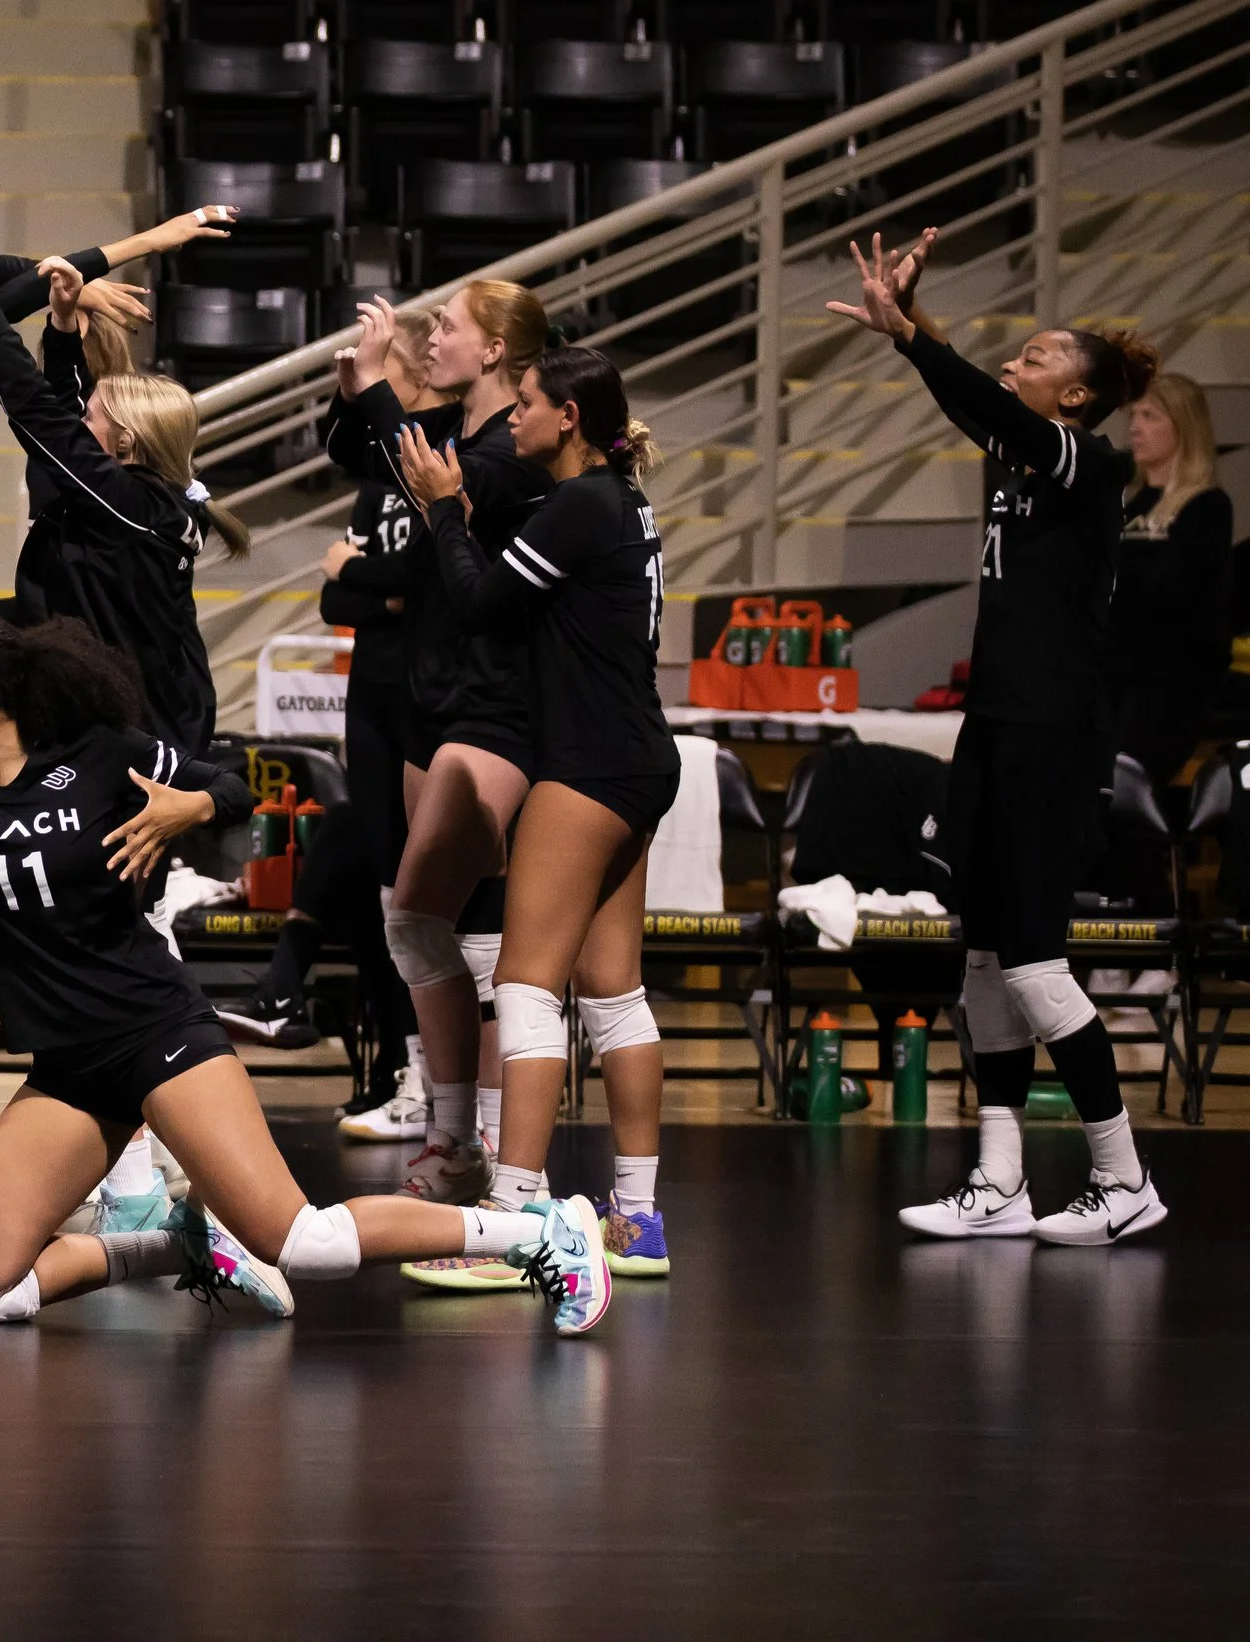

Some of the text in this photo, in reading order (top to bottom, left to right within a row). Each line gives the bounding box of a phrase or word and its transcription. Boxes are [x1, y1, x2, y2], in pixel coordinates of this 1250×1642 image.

[818, 675, 837, 707] G
[205, 915, 240, 933] LONG
[657, 915, 699, 934] BEACH
[702, 917, 741, 936] STATE
[867, 919, 910, 937] BEACH
[912, 920, 951, 937] STATE
[1072, 921, 1158, 940] BEACH STATE
